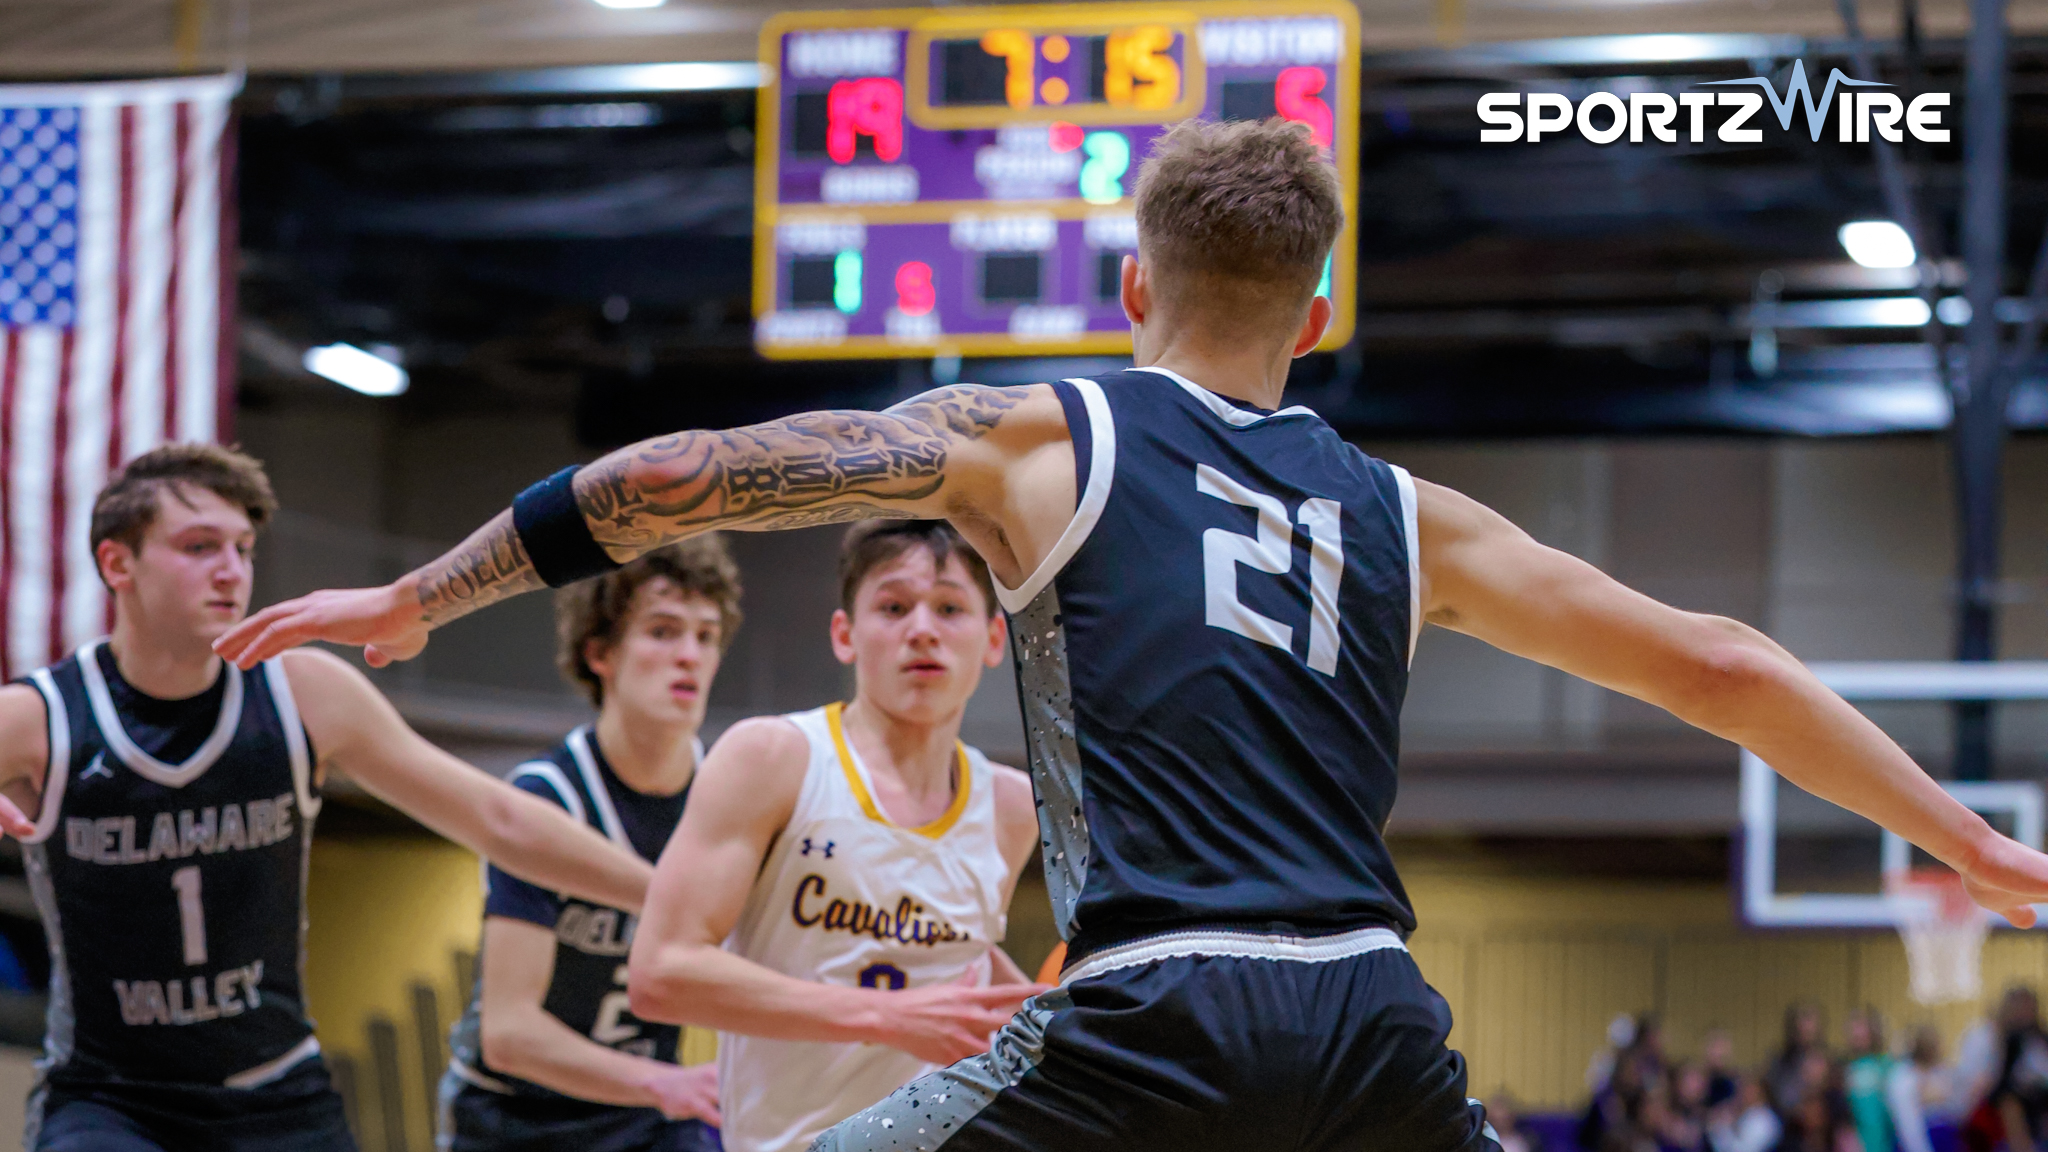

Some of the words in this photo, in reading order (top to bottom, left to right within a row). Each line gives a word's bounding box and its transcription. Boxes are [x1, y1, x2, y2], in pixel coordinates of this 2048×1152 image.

[980, 27, 1181, 110] 7:15
[826, 77, 903, 164] 19
[1079, 131, 1130, 204] 2
[1196, 462, 1345, 678] 21
[65, 794, 297, 866] DELAWARE
[171, 865, 208, 966] 1
[113, 959, 264, 1026] VALLEY
